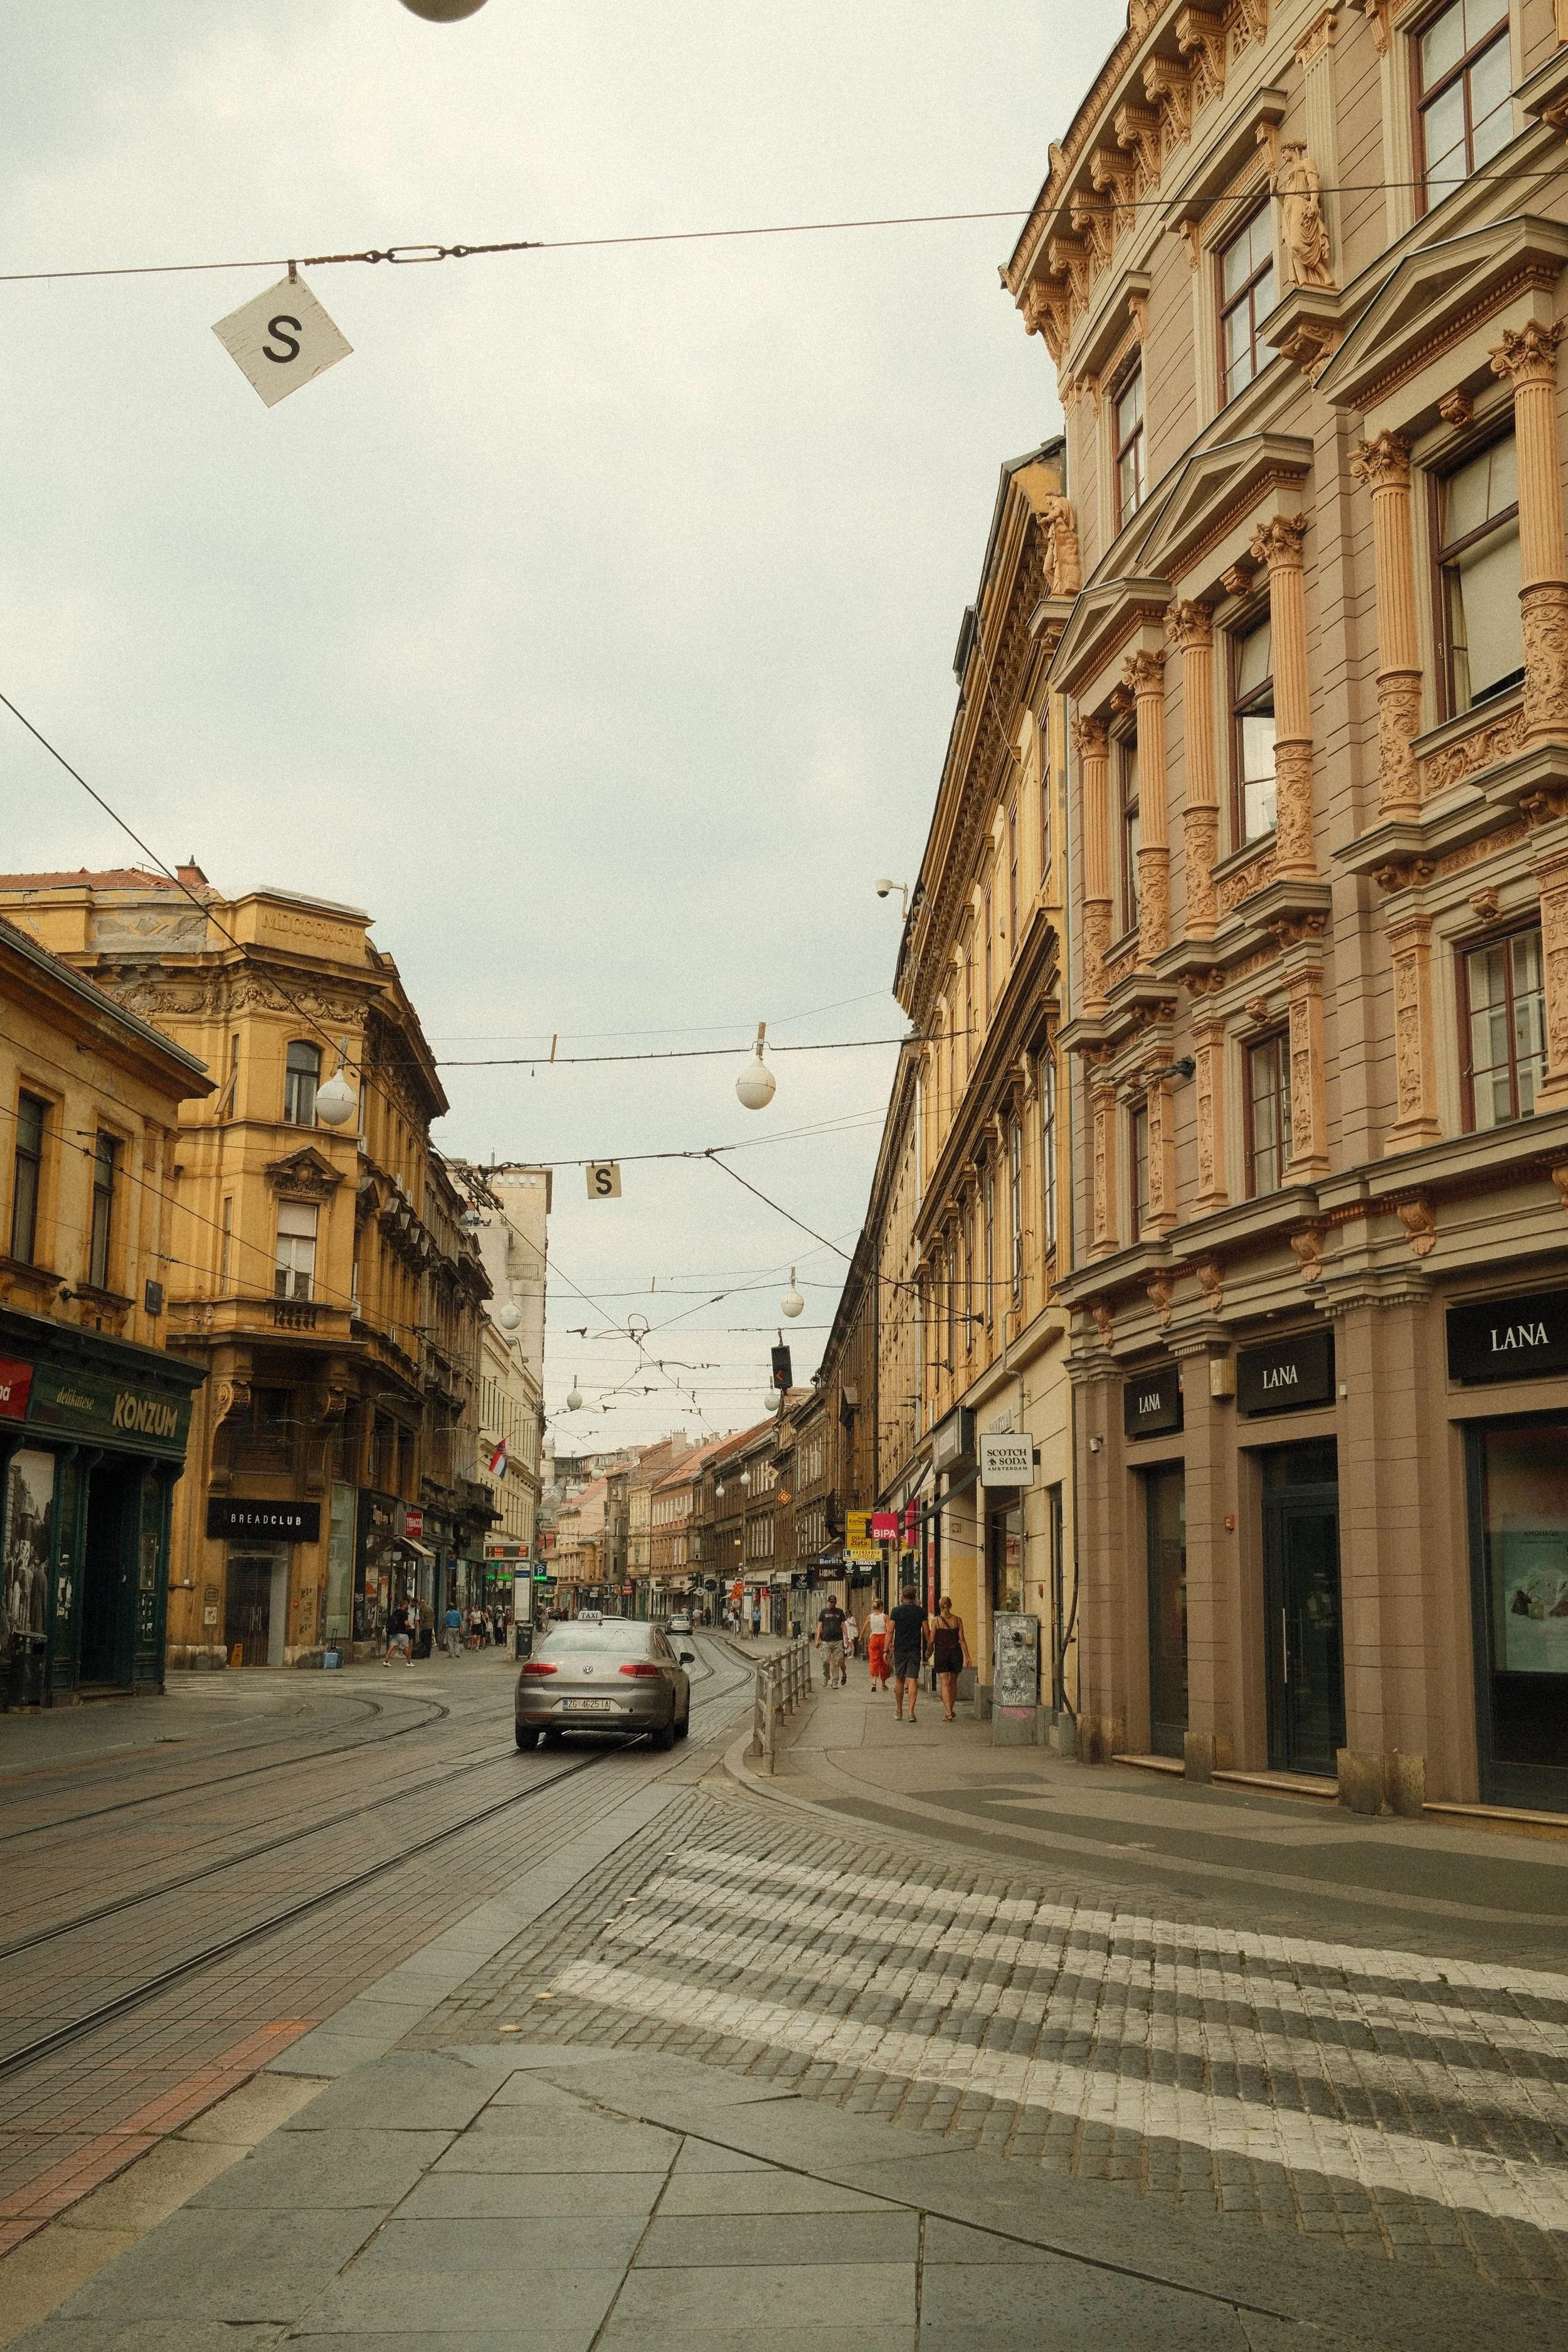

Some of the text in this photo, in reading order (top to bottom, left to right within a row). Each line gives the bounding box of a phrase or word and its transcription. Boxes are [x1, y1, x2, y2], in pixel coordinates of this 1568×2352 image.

[262, 314, 302, 364] S
[595, 1168, 612, 1195] S
[1490, 1322, 1550, 1352] LANA
[1262, 1364, 1299, 1389] LANA
[56, 1387, 95, 1411] delikatese
[1138, 1392, 1161, 1414] LANA
[112, 1391, 179, 1438] KONZUM
[987, 1448, 1027, 1456] SCOTCH
[999, 1457, 1027, 1465] SODA
[231, 1513, 302, 1525] BREADCLUB
[406, 1517, 421, 1528] TOBACCO
[873, 1529, 896, 1538] BIPA
[819, 1569, 837, 1577] HOME
[568, 1700, 577, 1708] ZG
